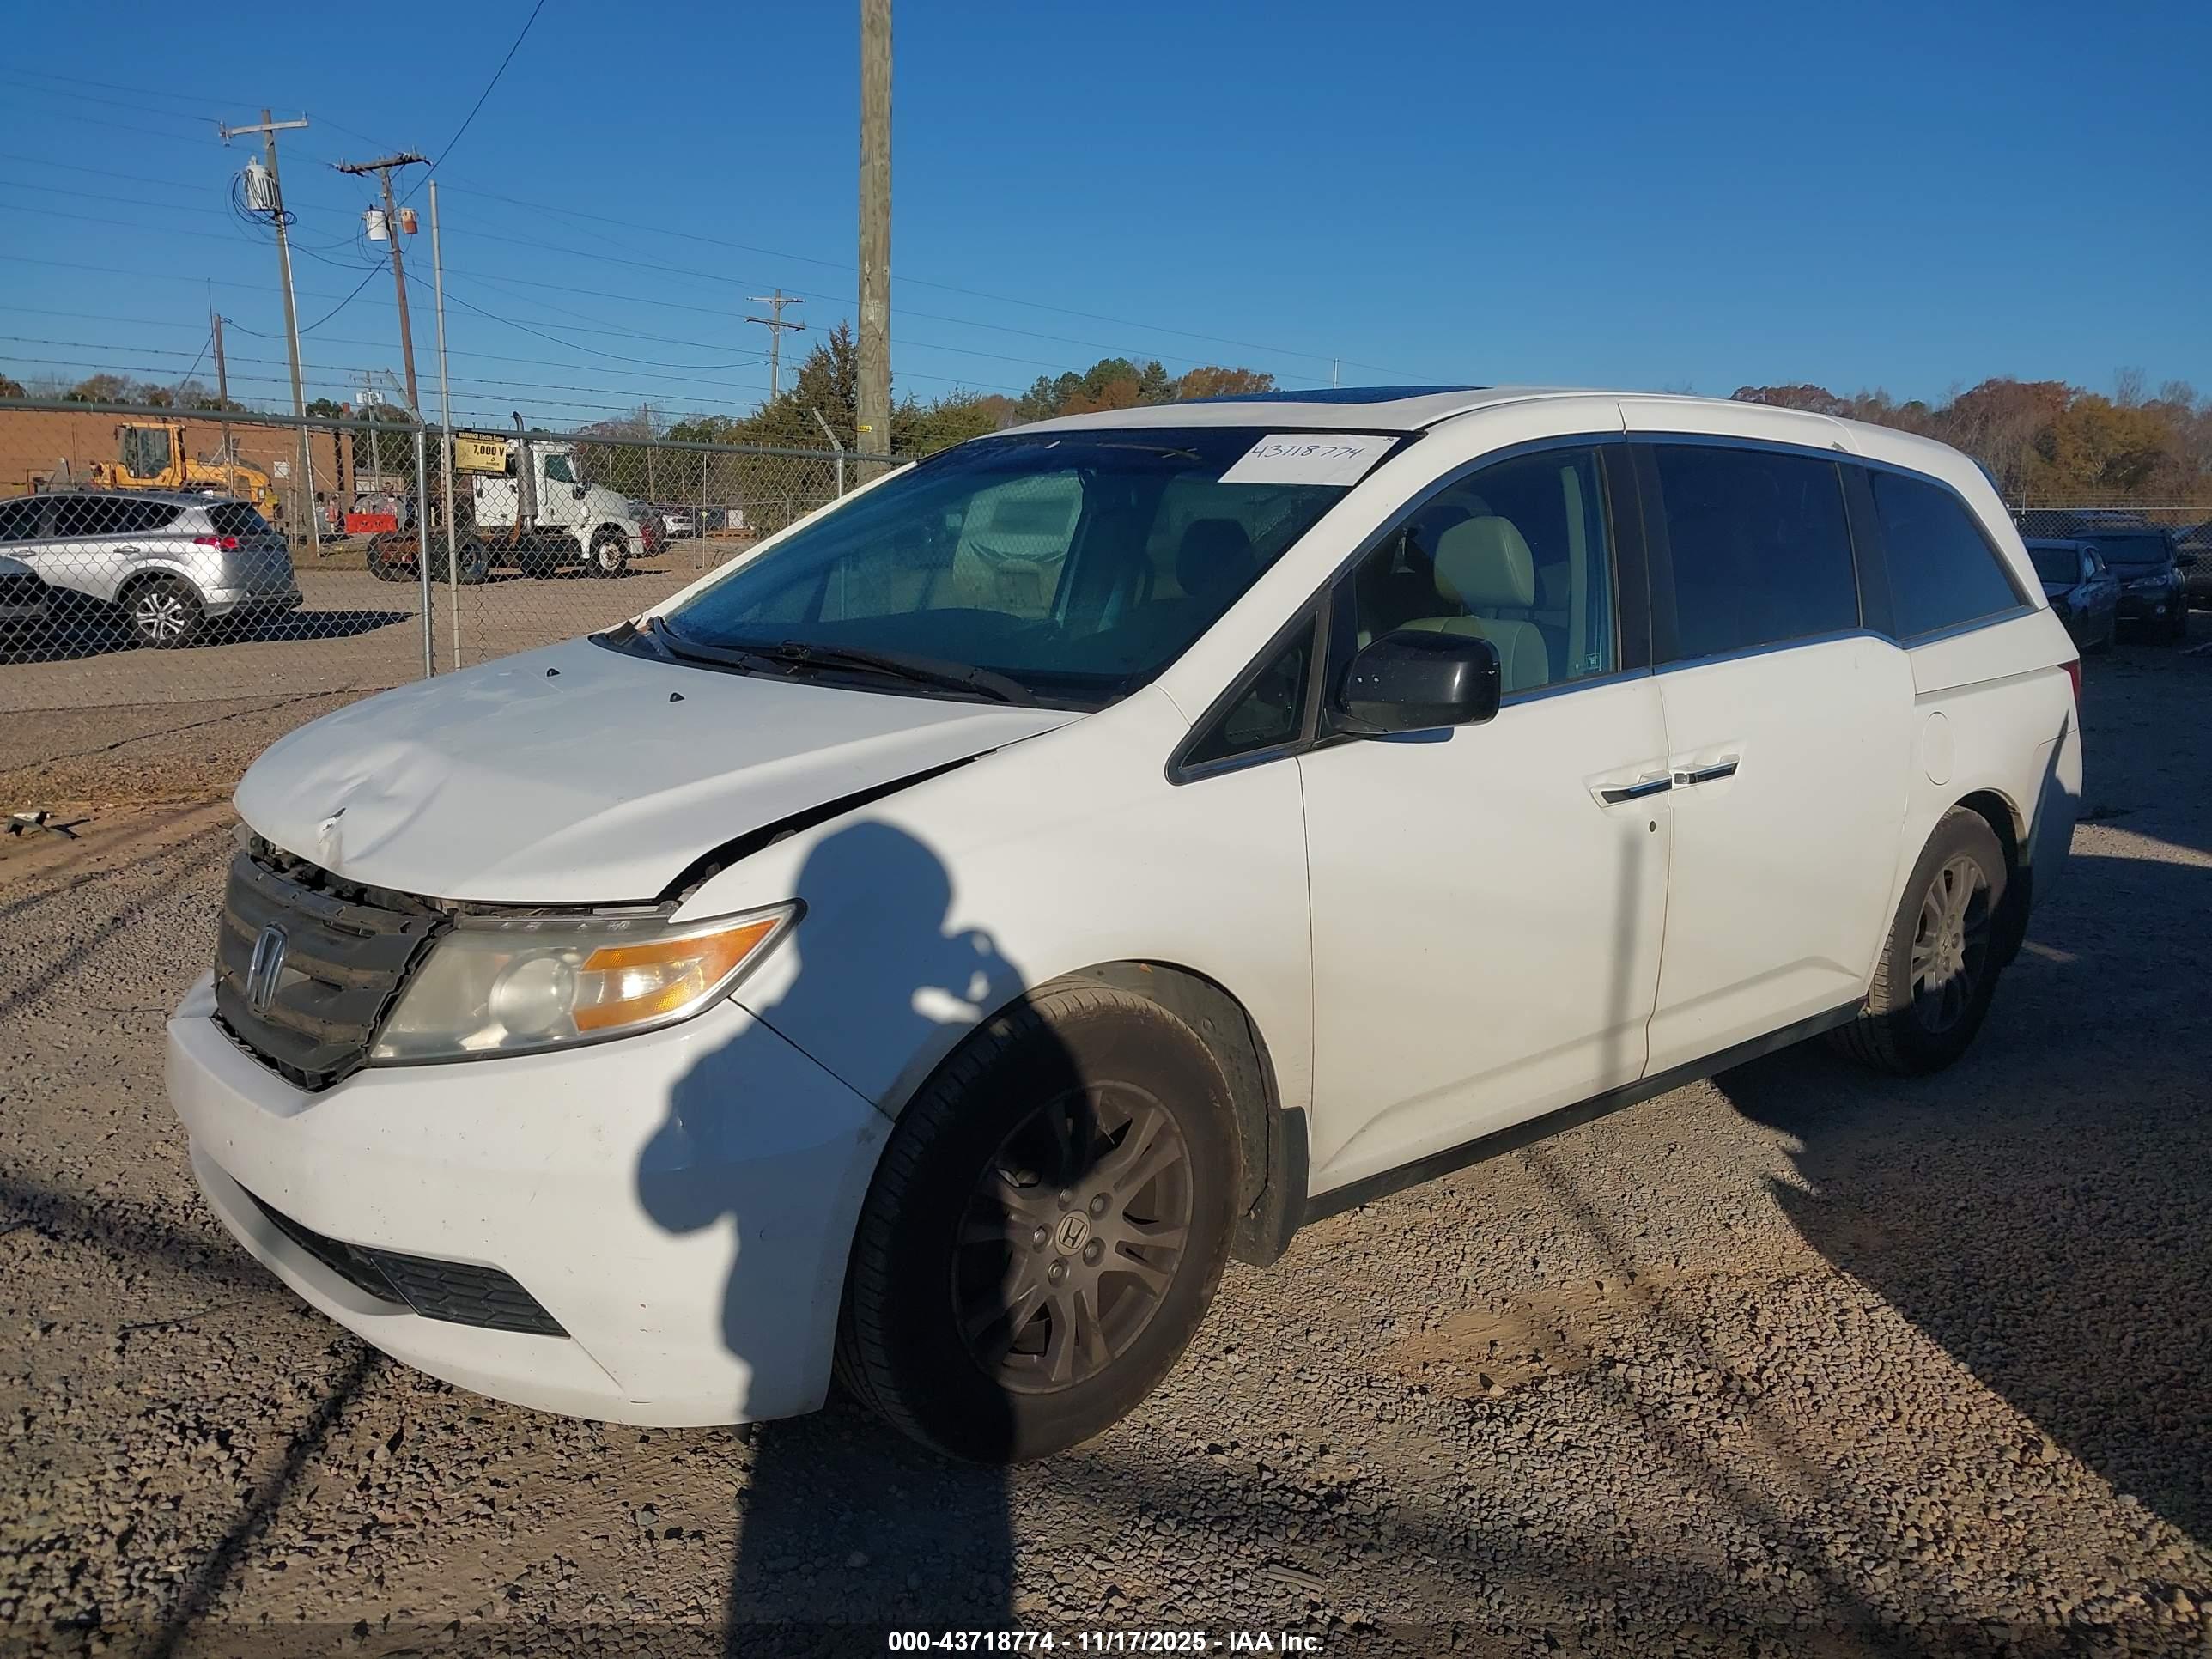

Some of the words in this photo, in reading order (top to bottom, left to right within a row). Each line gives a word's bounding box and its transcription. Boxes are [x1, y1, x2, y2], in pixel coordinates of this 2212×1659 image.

[473, 444, 497, 456] 7,000
[499, 447, 505, 457] V
[1251, 445, 1367, 459] 43718774
